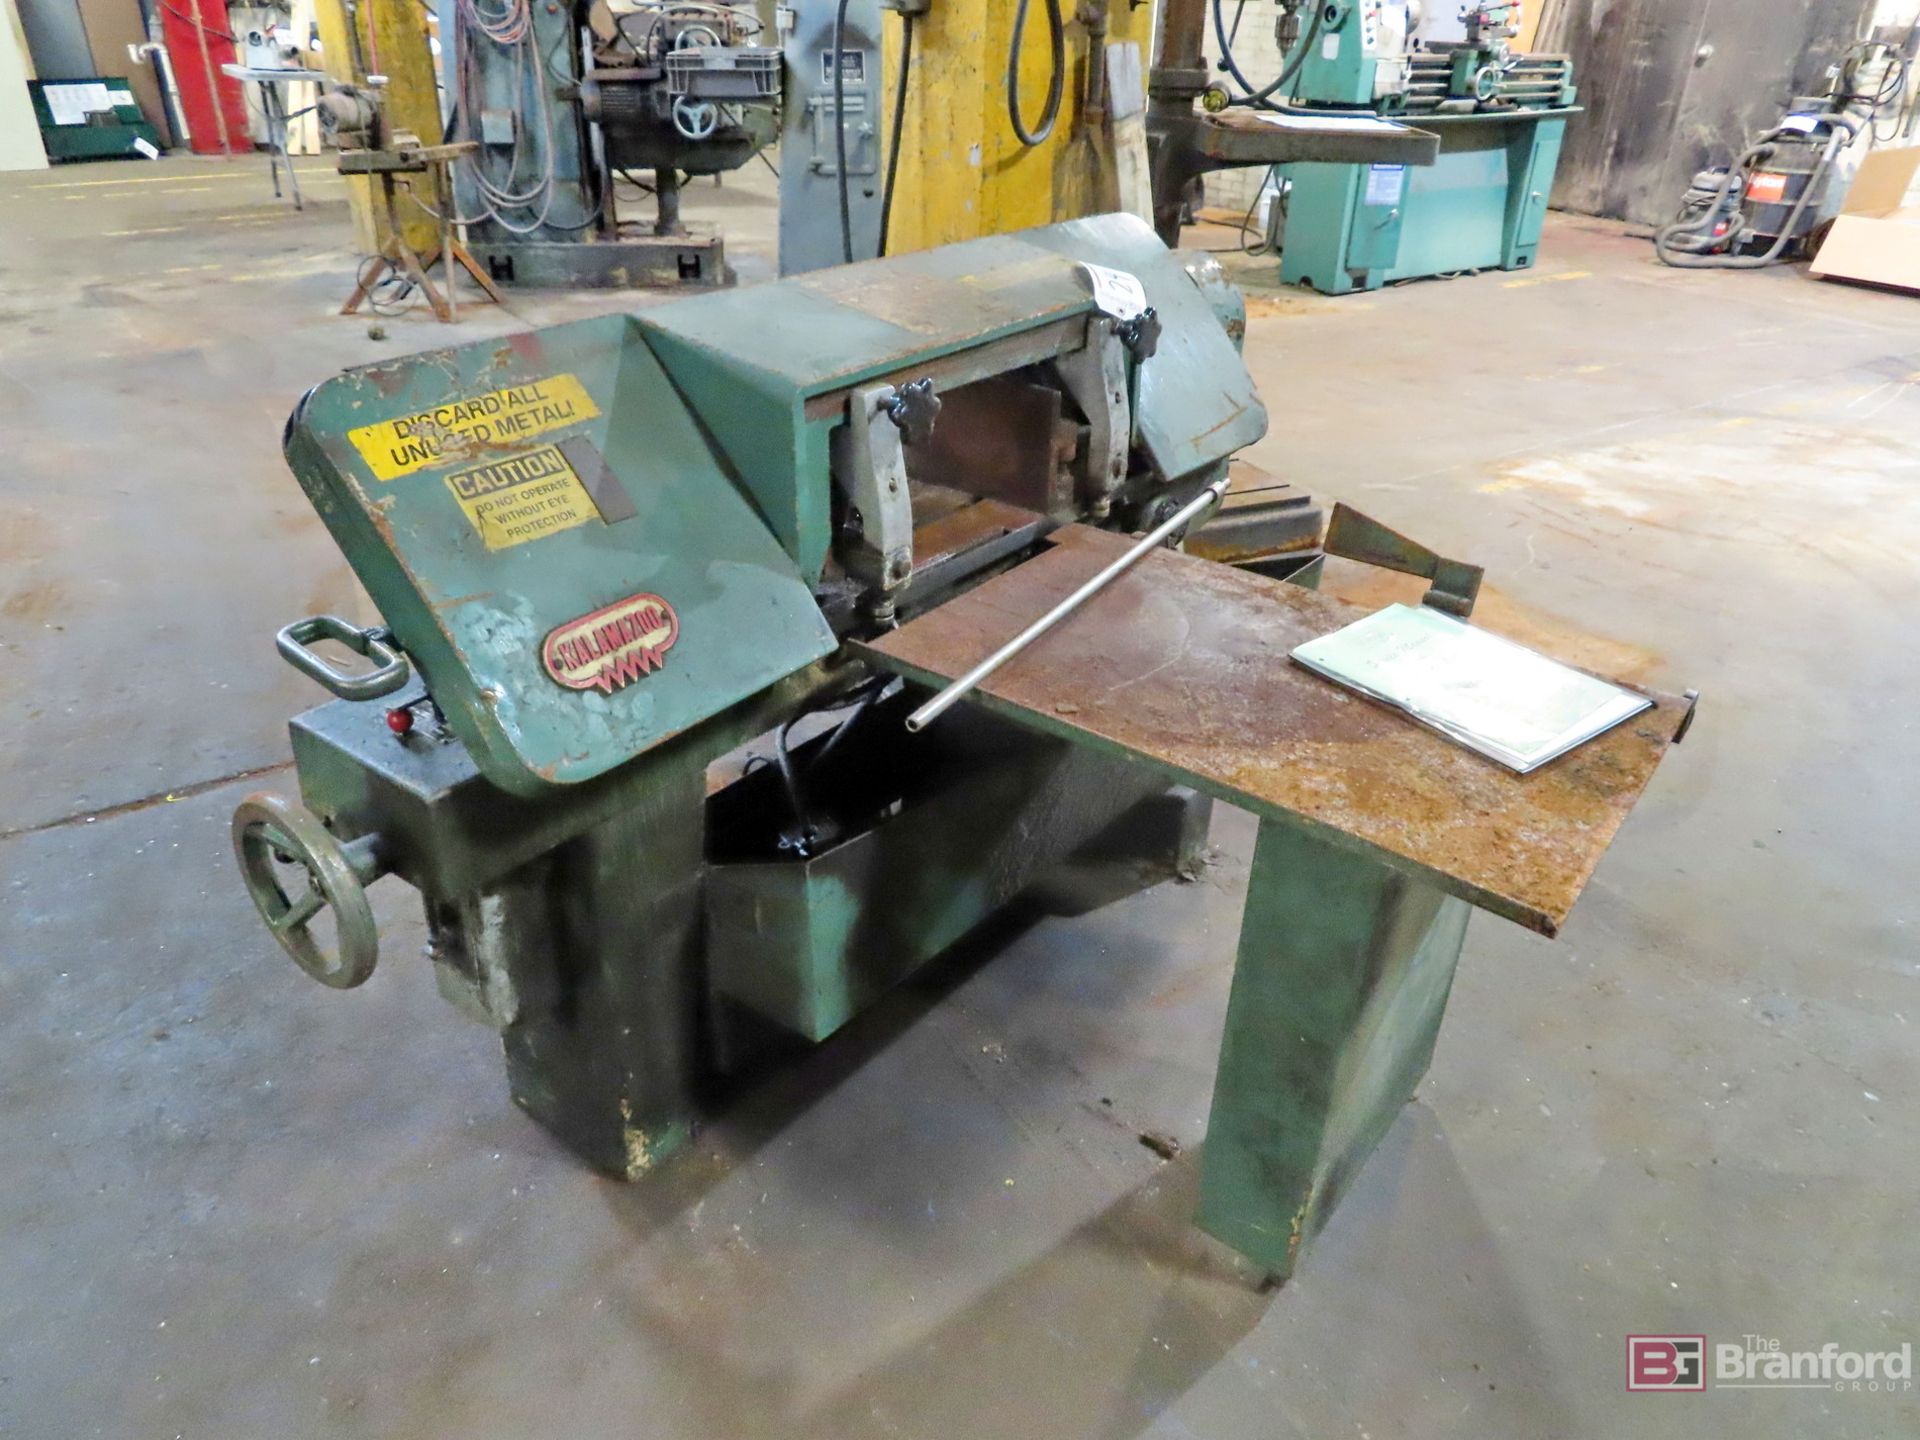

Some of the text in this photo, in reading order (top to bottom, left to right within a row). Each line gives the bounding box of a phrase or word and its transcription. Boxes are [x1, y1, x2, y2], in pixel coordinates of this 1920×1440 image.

[507, 384, 549, 409] ALL
[498, 402, 576, 437] METAL!
[452, 452, 564, 497] CAUTION
[476, 478, 571, 514] DO NOT OPERATE
[495, 494, 570, 525] WITHOUT EYE
[506, 509, 578, 539] PROTECTION
[558, 605, 664, 672] KALAMAZOO
